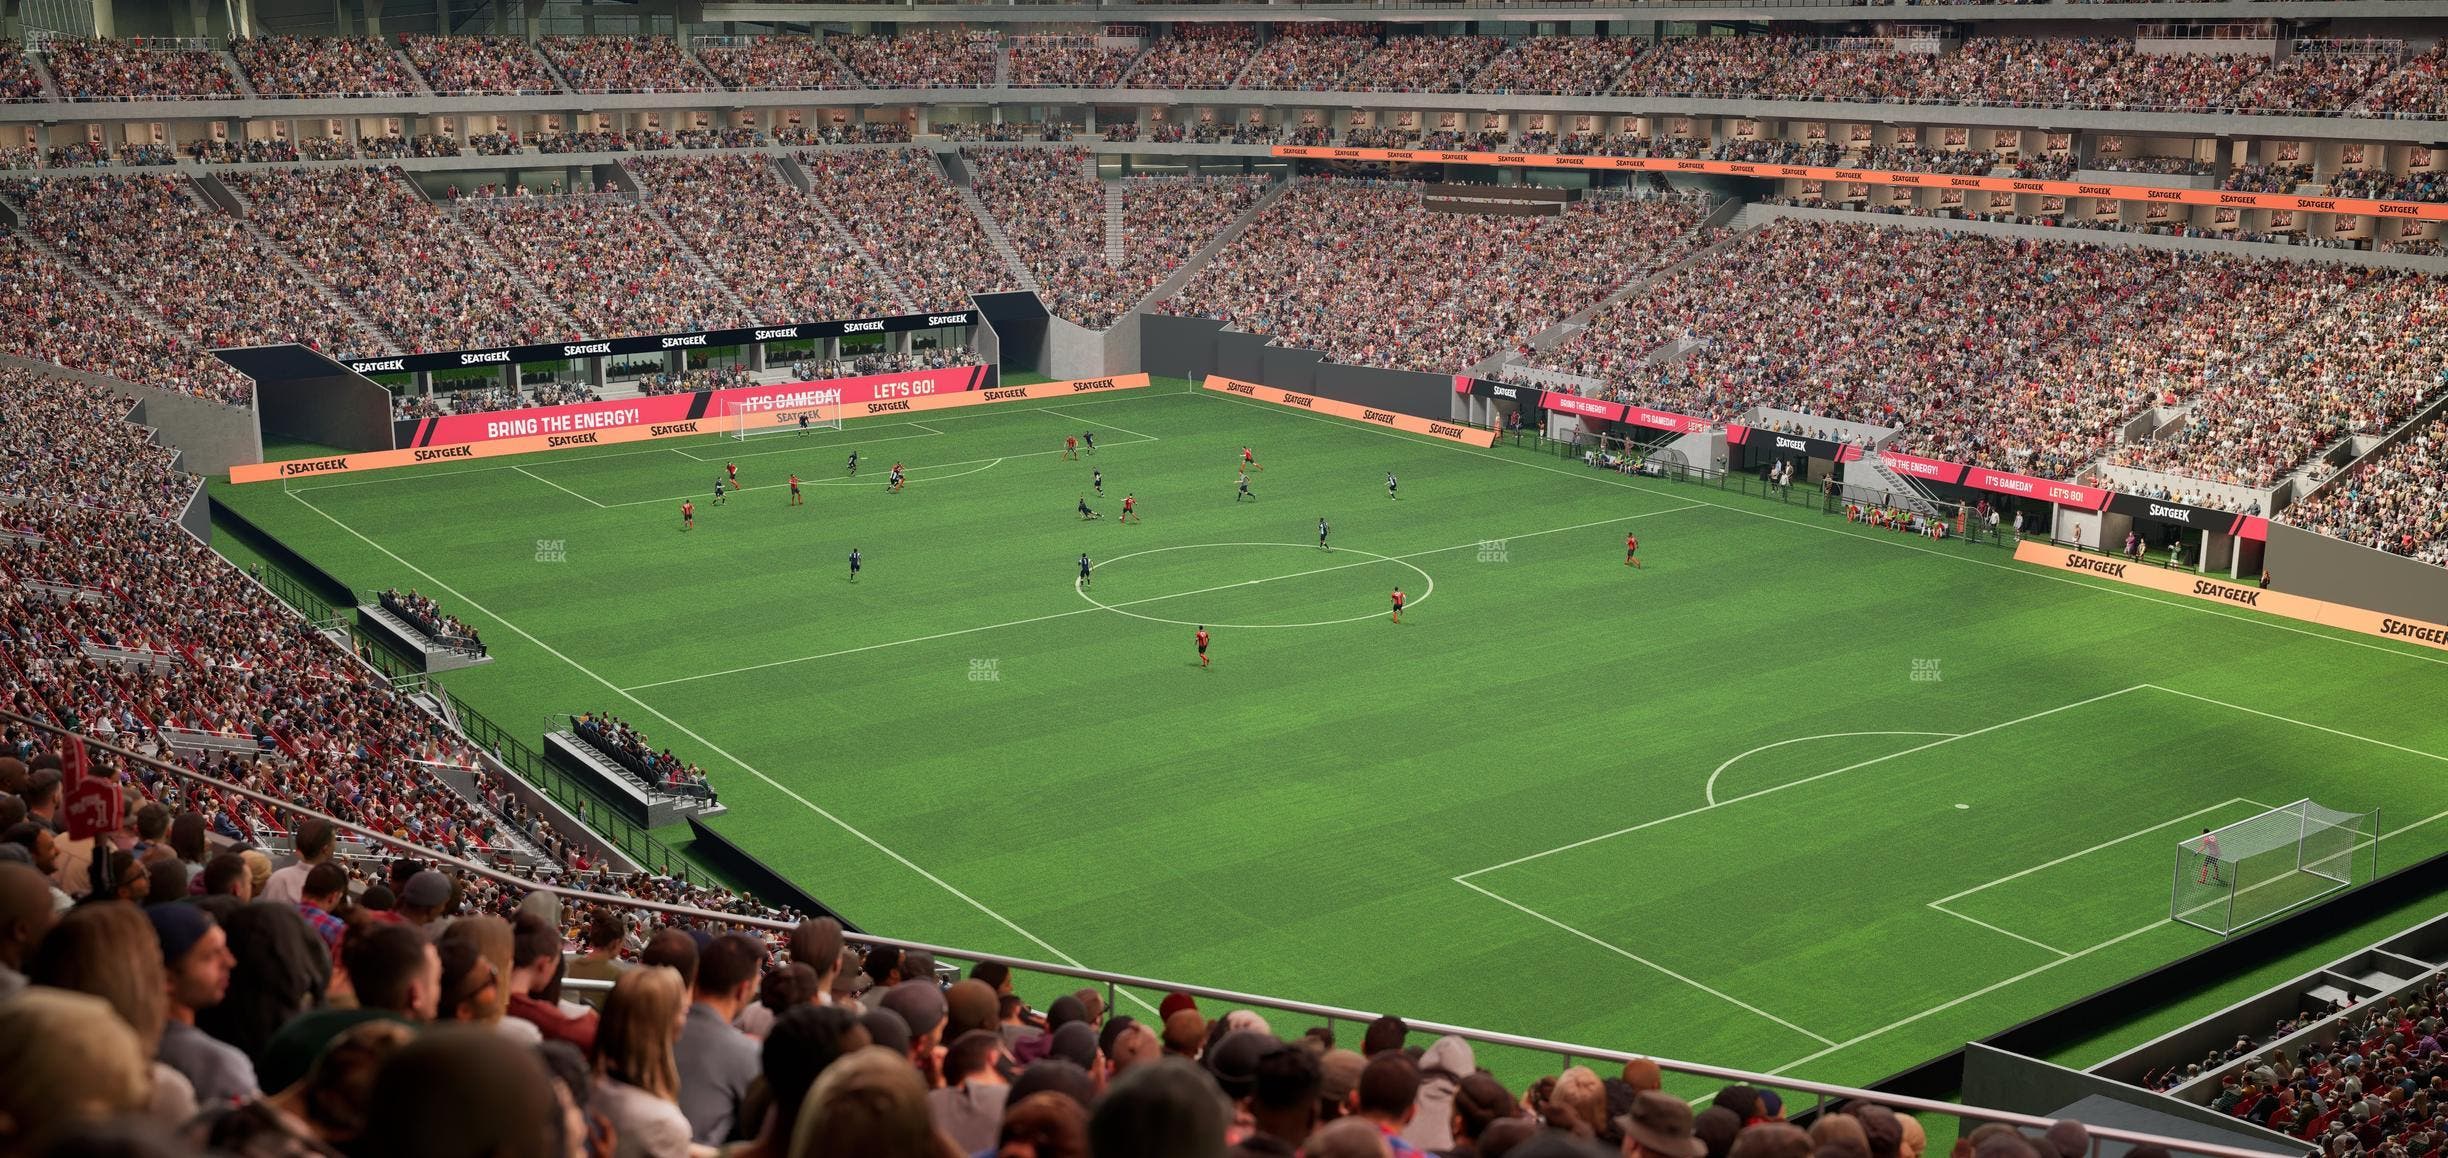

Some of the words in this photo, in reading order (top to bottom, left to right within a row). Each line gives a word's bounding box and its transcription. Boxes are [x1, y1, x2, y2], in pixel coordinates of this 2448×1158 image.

[1441, 153, 1468, 161] SEATGEEK
[1498, 155, 1525, 163] SEATGEEK
[1556, 157, 1584, 165] SEATGEEK
[1616, 159, 1645, 168] SEATGEEK
[1677, 162, 1705, 170] SEATGEEK
[1730, 164, 1755, 173] SEATGEEK
[1781, 167, 1807, 177] SEATGEEK
[1835, 171, 1862, 180] SEATGEEK
[1891, 174, 1920, 184] SEATGEEK
[1951, 178, 1981, 188] SEATGEEK
[2013, 182, 2044, 192] SEATGEEK
[2078, 186, 2111, 196] SEATGEEK
[2147, 190, 2182, 201] SEATGEEK
[2220, 194, 2257, 206] SEATGEEK
[2297, 199, 2335, 211] SEATGEEK
[2379, 204, 2419, 216] SEATGEEK
[352, 359, 405, 373] SEATGEEK
[460, 350, 511, 365] SEATGEEK
[564, 342, 612, 357] SEATGEEK
[661, 334, 707, 348] SEATGEEK
[754, 327, 798, 341] SEATGEEK
[843, 320, 885, 333] SEATGEEK
[928, 314, 968, 326] SEATGEEK
[776, 388, 842, 409] GAMEDAY
[873, 380, 910, 400] LET'S
[912, 379, 935, 396] GO!
[1227, 381, 1256, 396] SEATGEEK
[1283, 392, 1314, 408] SEATGEEK
[1362, 409, 1396, 426] SEATGEEK
[1429, 422, 1465, 440] SEATGEEK
[1493, 385, 1518, 399] SEATGEEK
[286, 458, 349, 476] SEATGEEK
[414, 445, 473, 461] SEATGEEK
[548, 432, 598, 448] SEATGEEK
[651, 421, 699, 437] SEATGEEK
[867, 399, 910, 414] SEATGEEK
[983, 387, 1028, 402] SEATGEEK
[1073, 378, 1115, 392] SEATGEEK
[487, 418, 538, 438] BRING
[541, 415, 572, 433] THE
[575, 408, 640, 430] ENERGY!
[1776, 436, 1807, 452] SEATGEEK
[1910, 461, 1939, 476] ENERGY!
[1985, 475, 1999, 487] IT'S
[1999, 478, 2034, 493] GAMEDAY
[2049, 486, 2070, 499] LET'S
[2070, 490, 2084, 503] GO!
[2149, 503, 2191, 523] SEATGEEK
[2066, 553, 2128, 579] SEATGEEK
[2193, 579, 2262, 607] SEATGEEK
